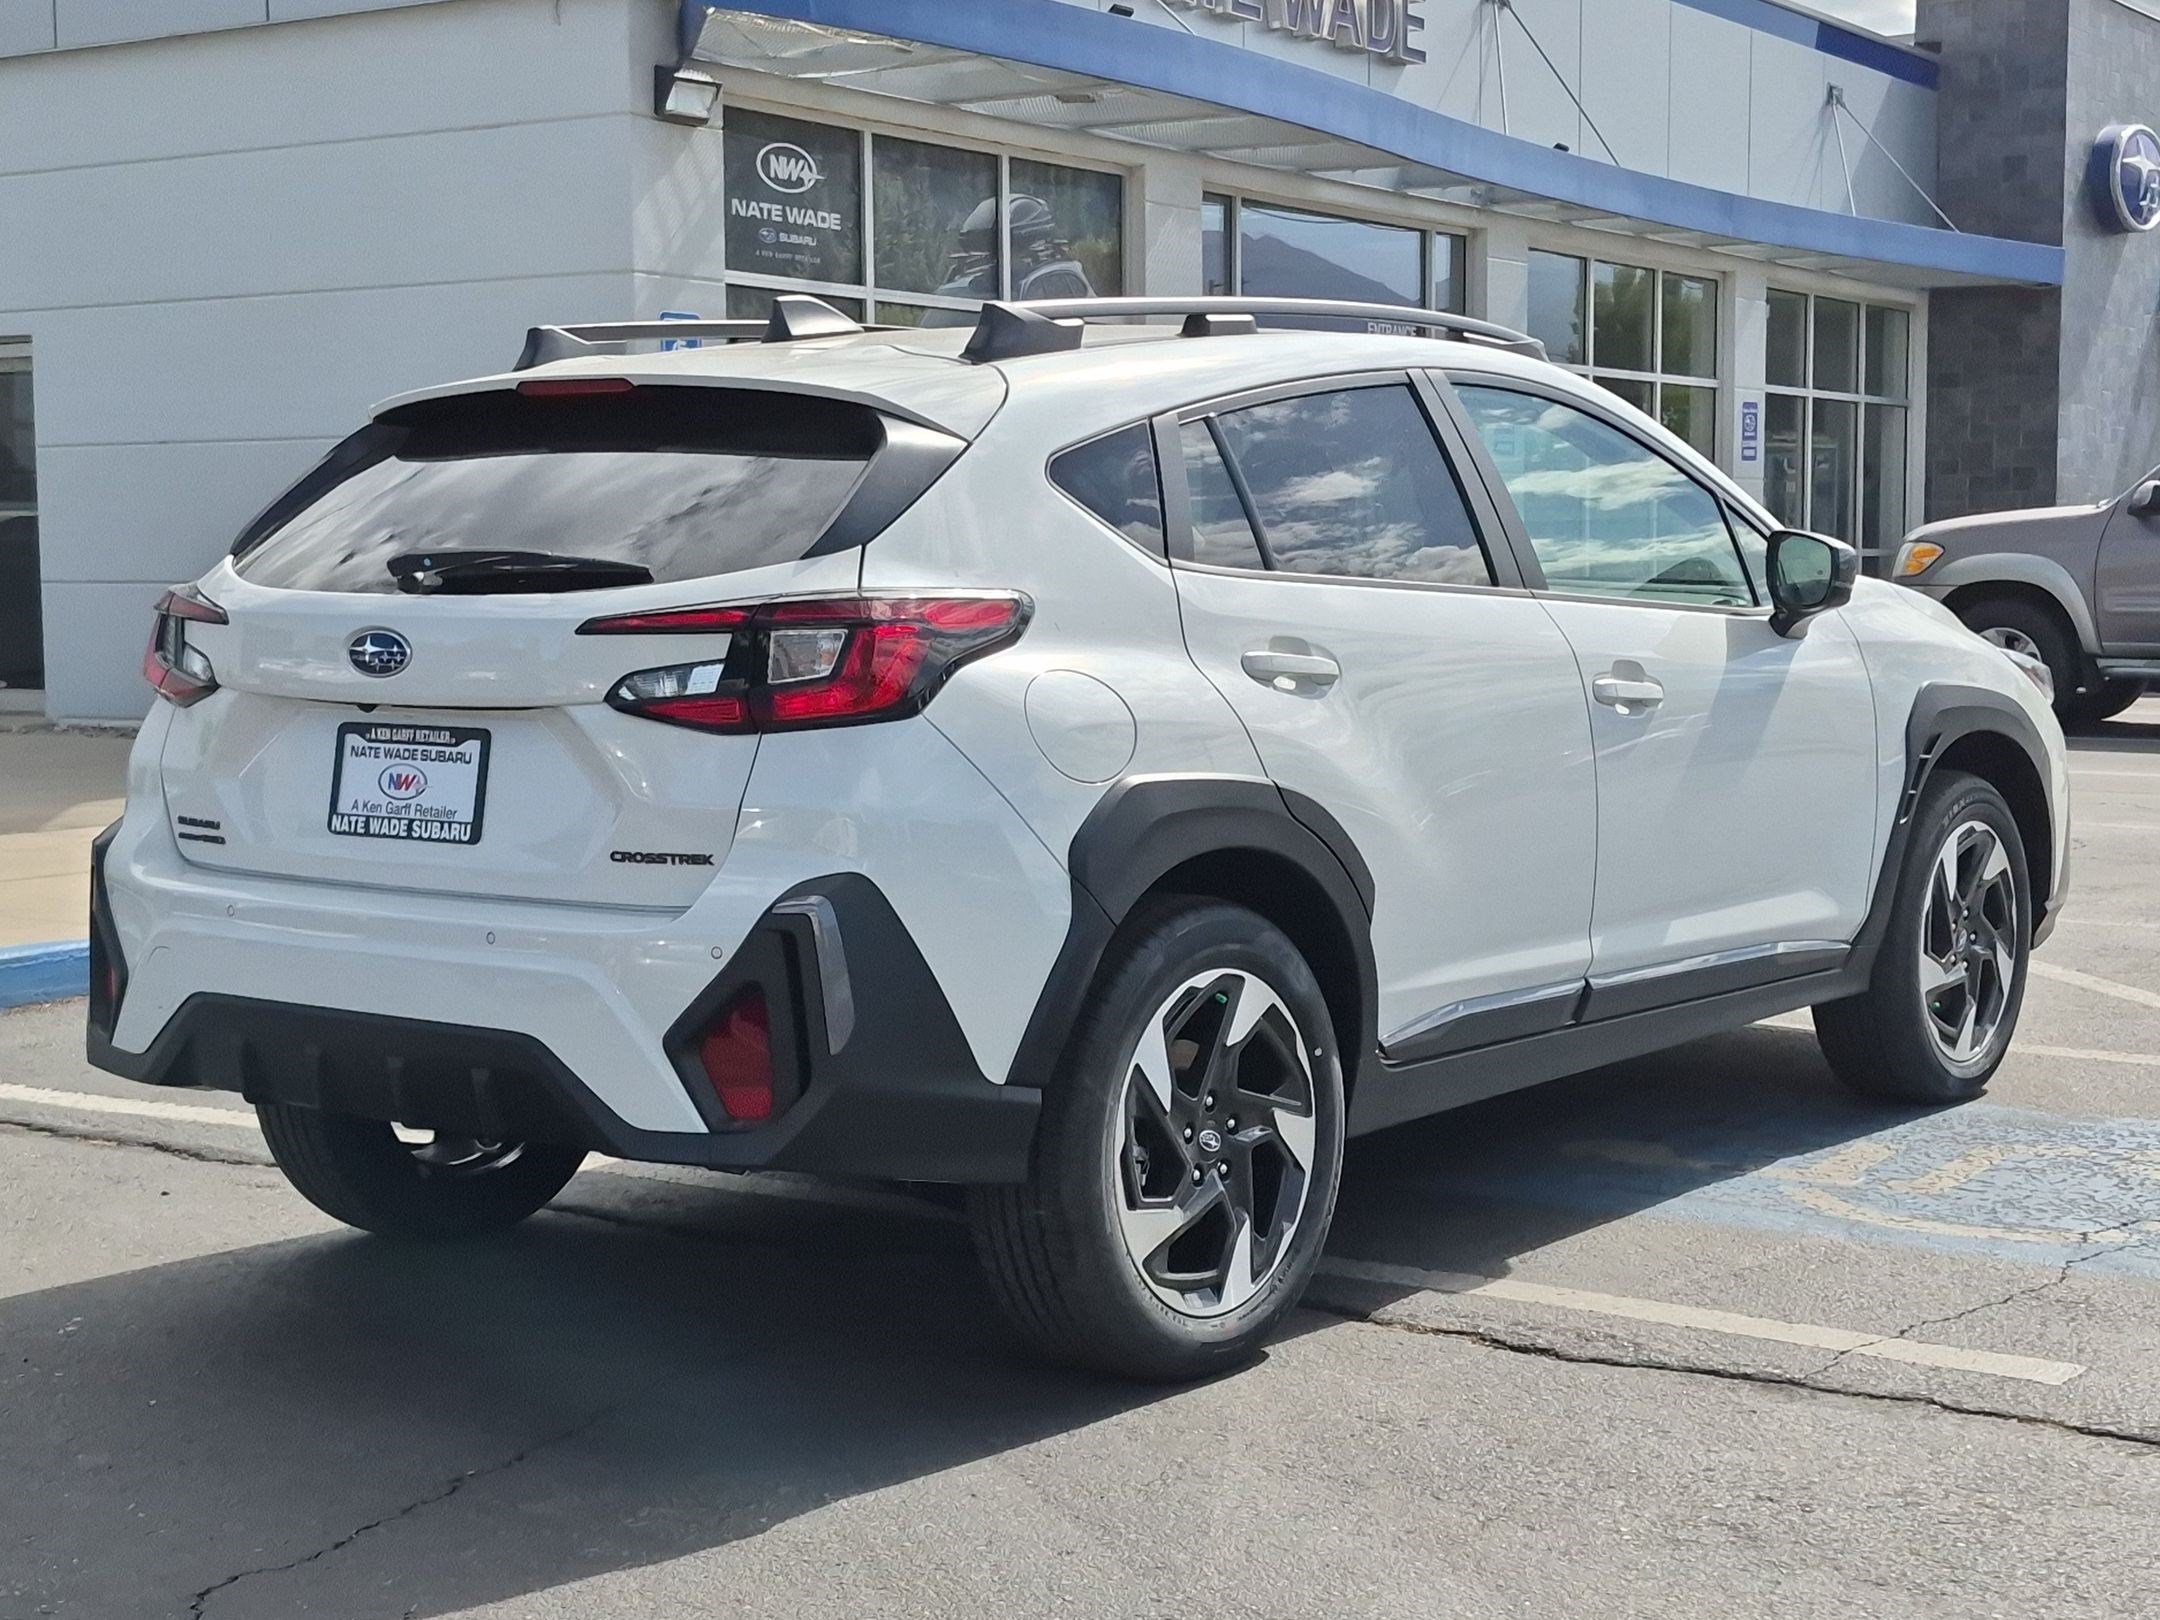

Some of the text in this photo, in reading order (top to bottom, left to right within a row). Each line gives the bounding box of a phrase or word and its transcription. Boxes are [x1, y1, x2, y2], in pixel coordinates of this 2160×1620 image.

[731, 198, 842, 231] NATE WADE
[779, 232, 817, 246] SUBARU
[1367, 321, 1417, 336] ENTRANCE
[351, 745, 472, 764] NATE WADE SUBARU
[351, 800, 458, 820] A Ken Garff Retailer
[331, 814, 472, 842] NATE WADE SUBARU
[610, 850, 715, 866] CROSSTREK
